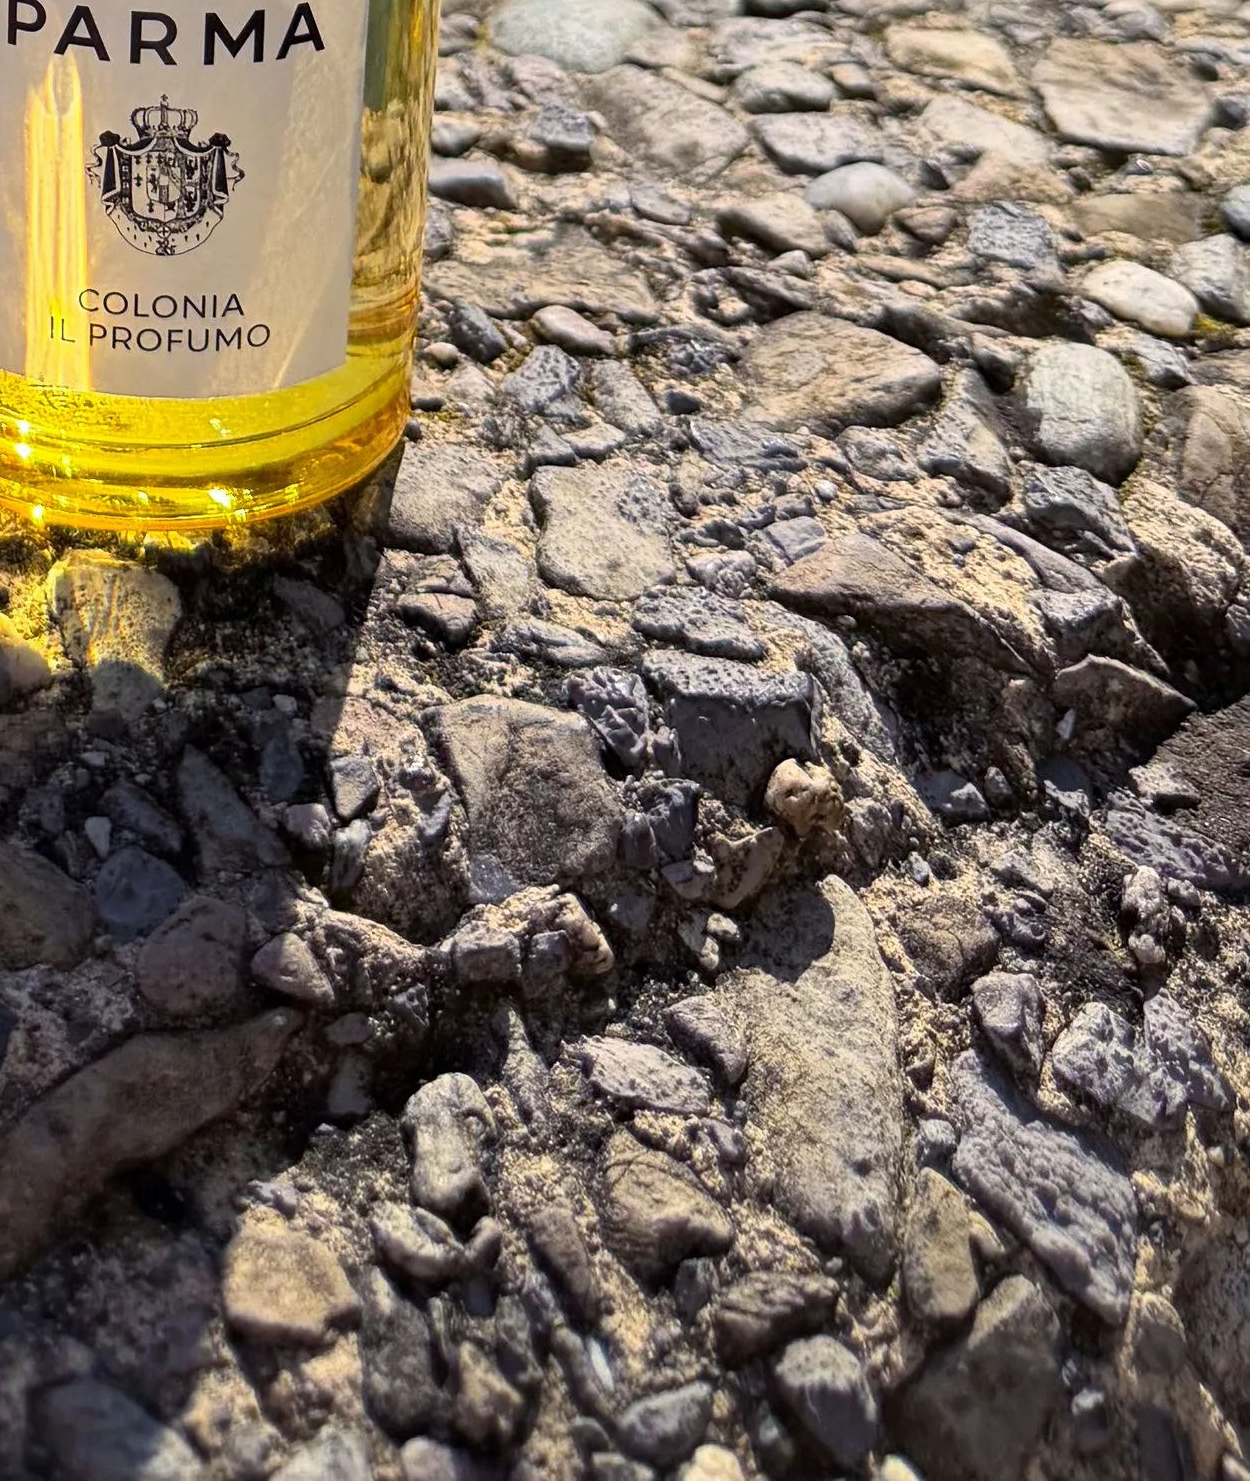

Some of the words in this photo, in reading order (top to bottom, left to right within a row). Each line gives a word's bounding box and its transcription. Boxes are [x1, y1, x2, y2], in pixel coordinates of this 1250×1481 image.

[78, 288, 245, 319] COLONIA
[50, 316, 76, 343] IL
[89, 322, 271, 353] PROFUMO
